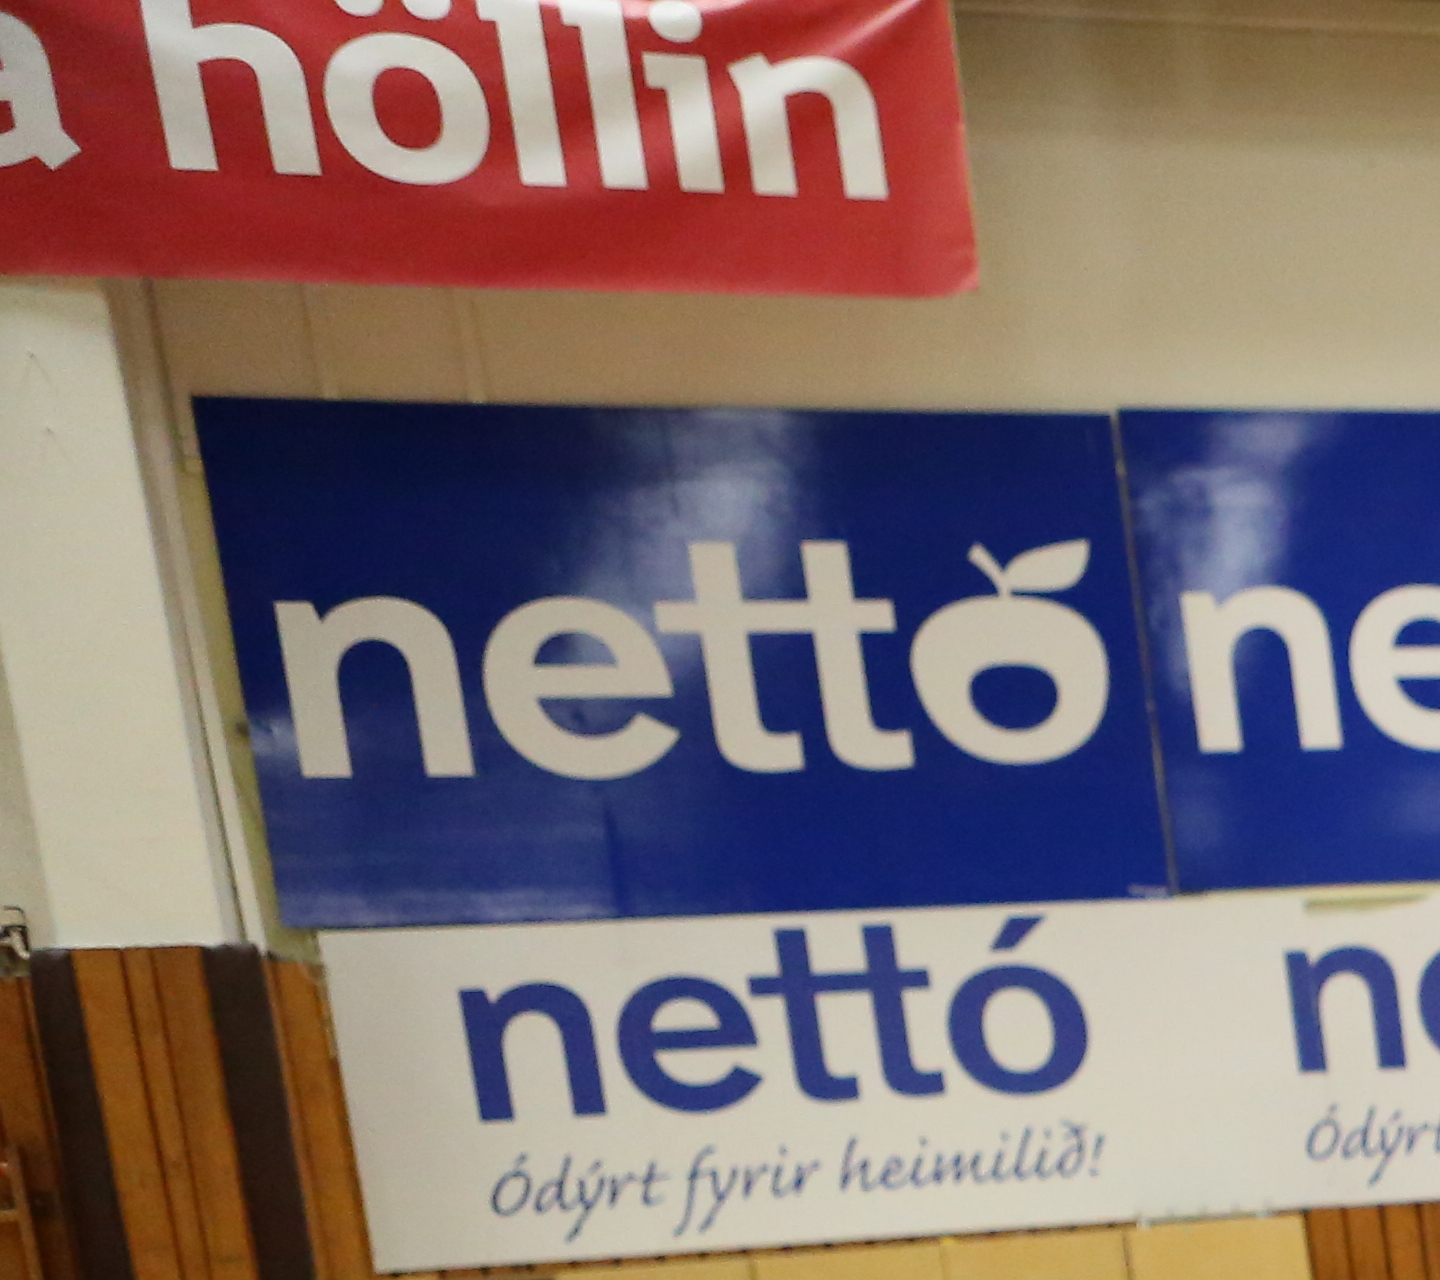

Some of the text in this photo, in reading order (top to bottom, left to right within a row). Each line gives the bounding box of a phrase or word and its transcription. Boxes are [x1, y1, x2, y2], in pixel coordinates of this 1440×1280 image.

[146, 0, 889, 200] höllin
[458, 917, 1089, 1125] nettó
[489, 1130, 1107, 1241] Ódýrt fyrir heimilið!
